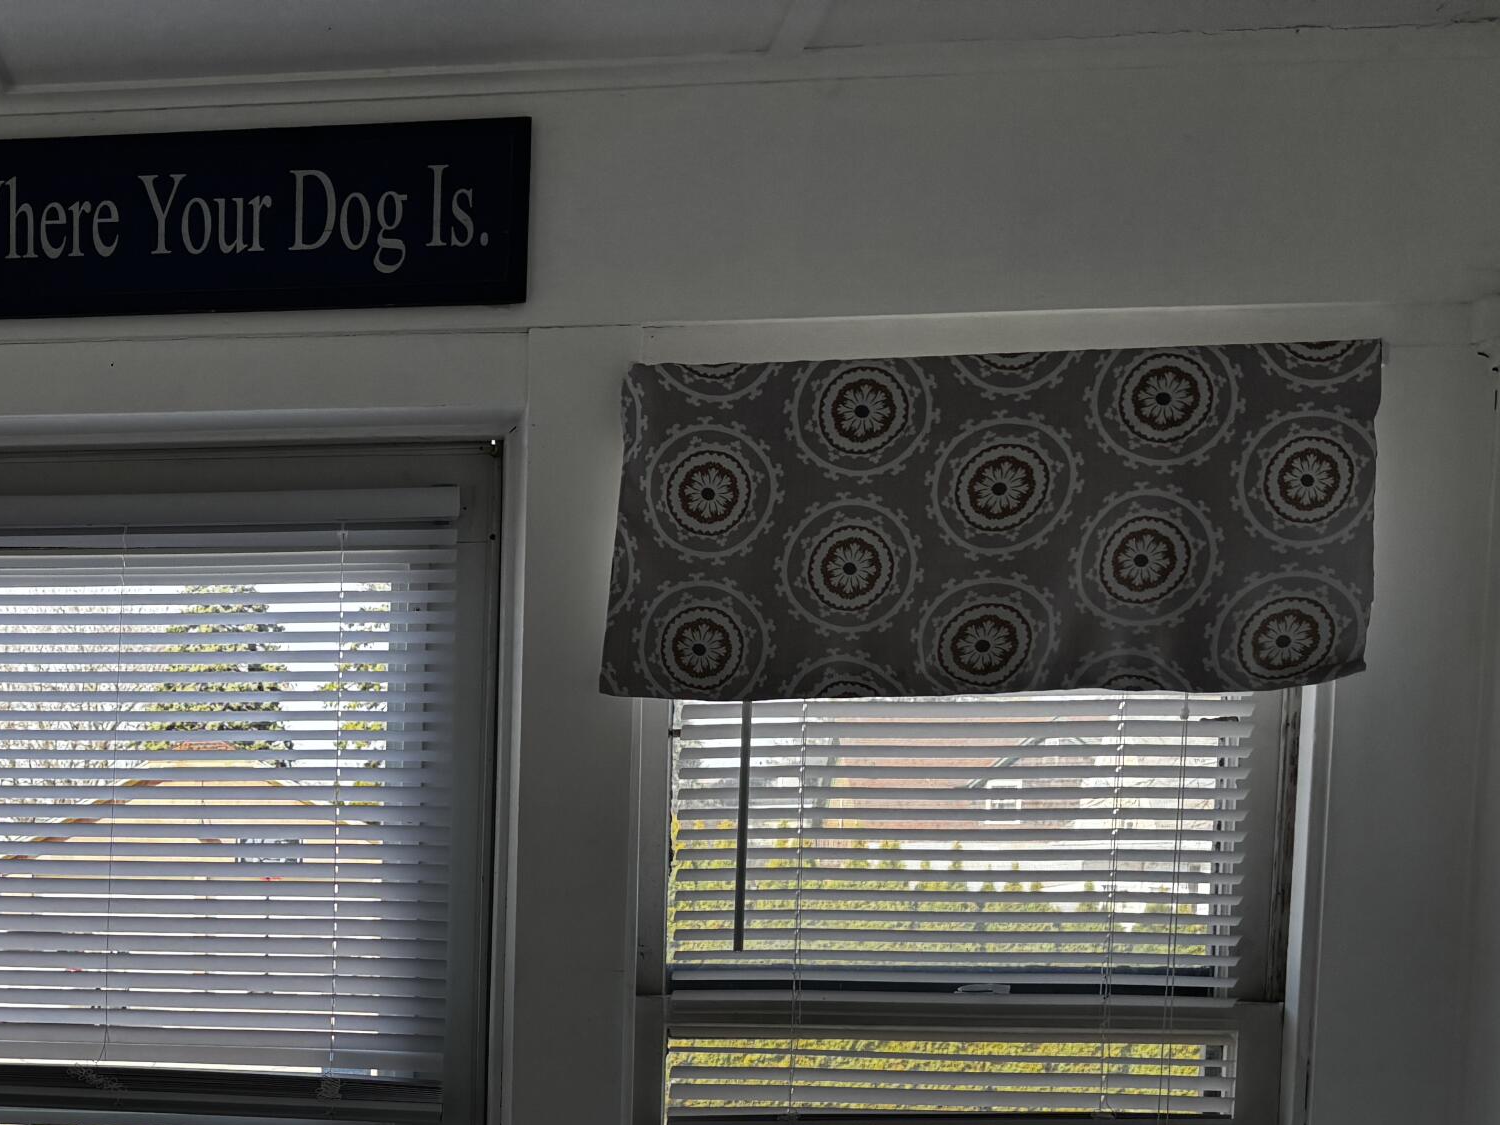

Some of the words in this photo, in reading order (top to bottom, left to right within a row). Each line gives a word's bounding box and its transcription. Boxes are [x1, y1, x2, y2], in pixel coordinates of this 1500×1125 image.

[137, 173, 272, 255] Your
[288, 169, 408, 274] Dog
[426, 164, 489, 247] Is.
